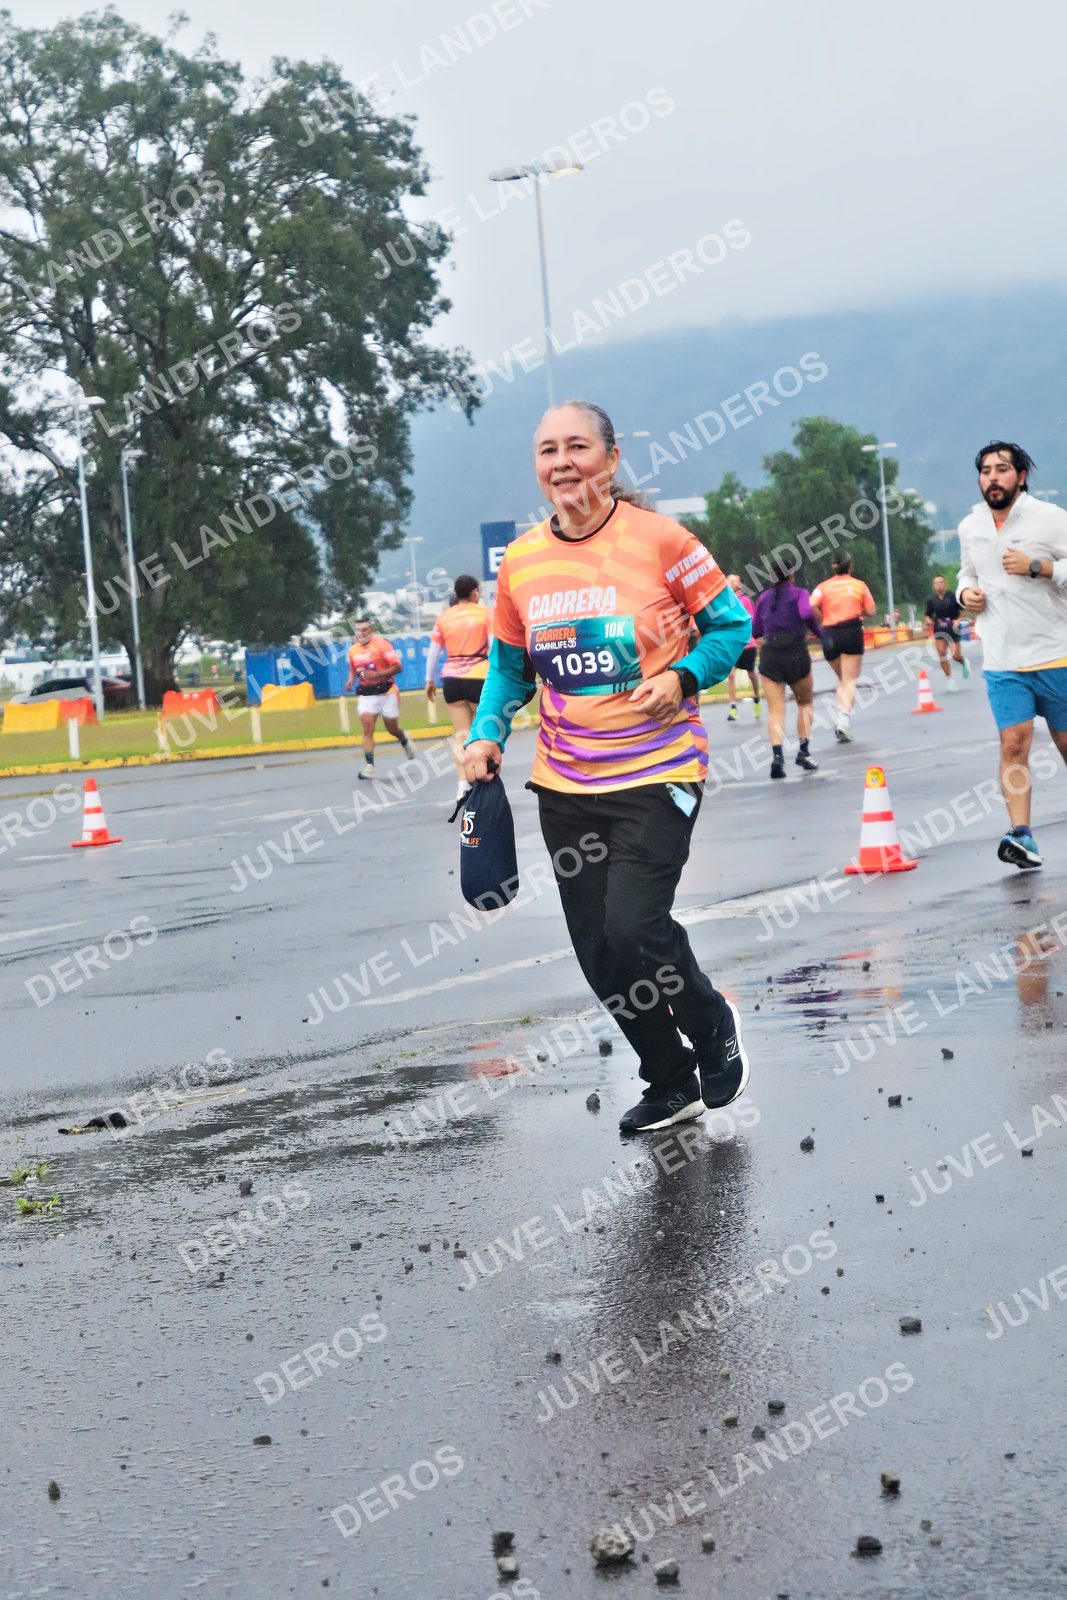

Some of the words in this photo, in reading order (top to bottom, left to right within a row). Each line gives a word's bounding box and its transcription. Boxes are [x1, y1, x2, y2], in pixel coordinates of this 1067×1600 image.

[528, 586, 616, 620] CARRERA
[536, 627, 576, 642] CARRERA
[604, 622, 625, 638] 10K
[552, 650, 614, 676] 1039
